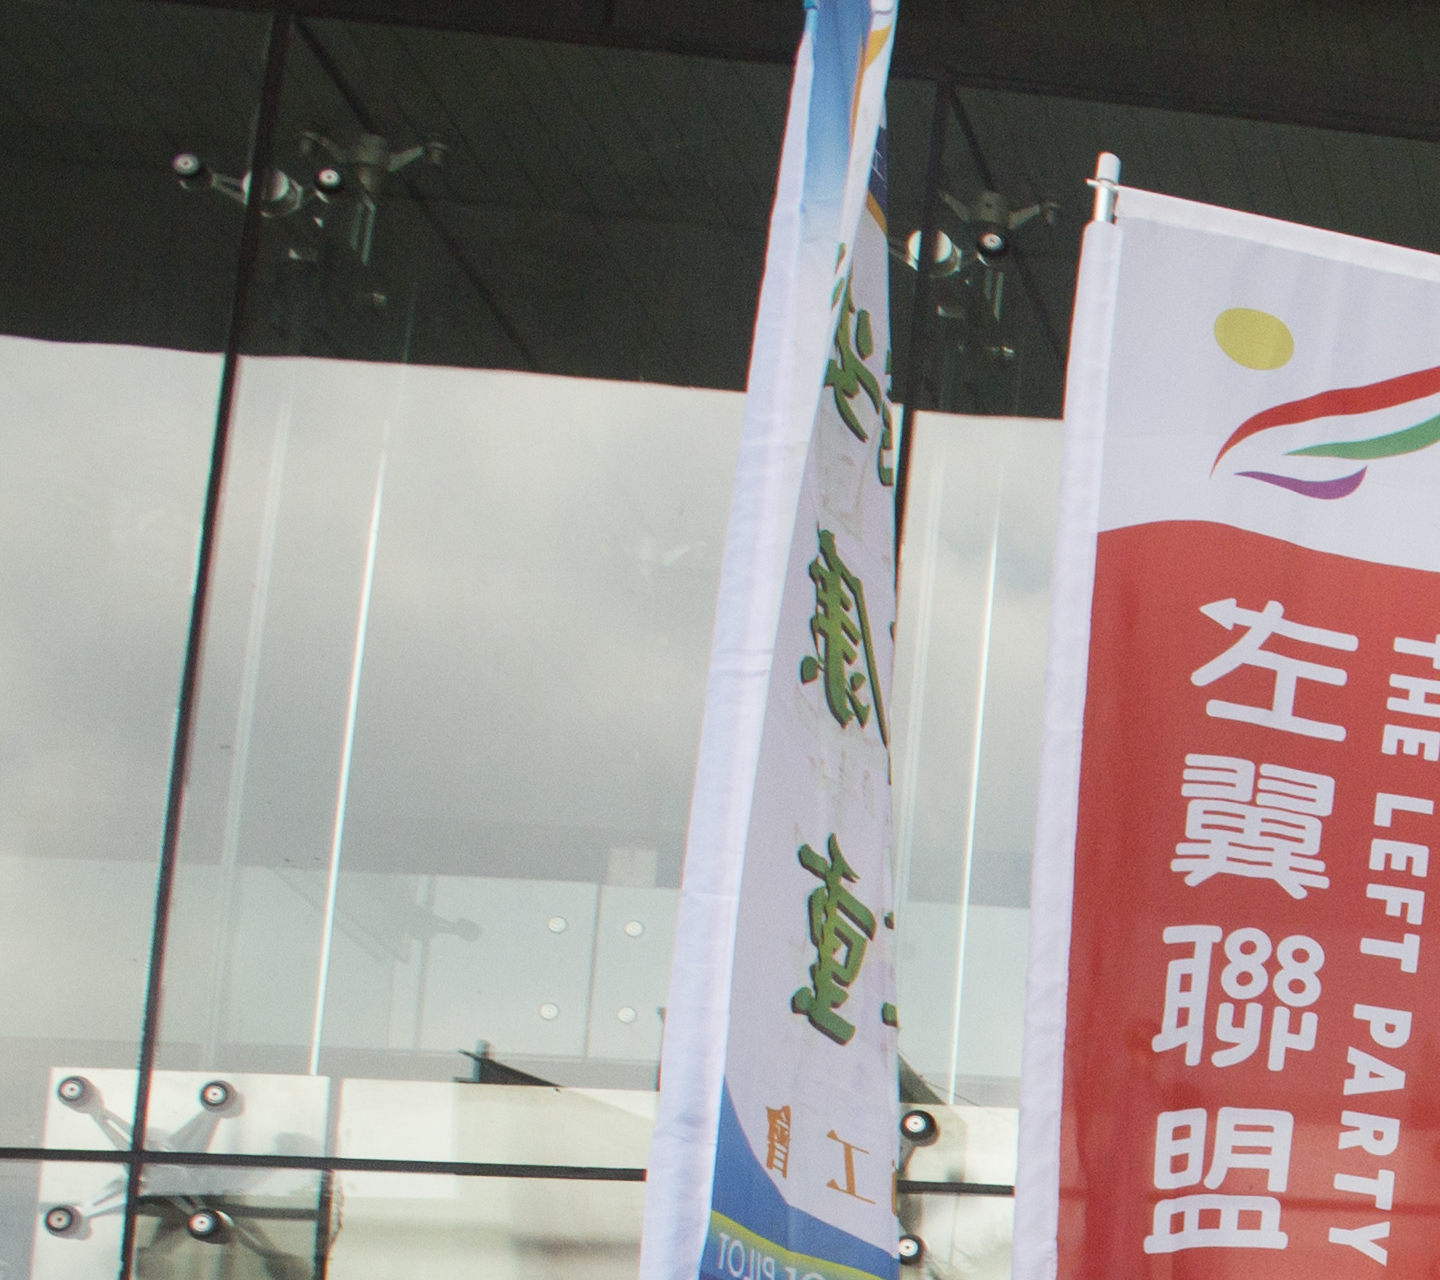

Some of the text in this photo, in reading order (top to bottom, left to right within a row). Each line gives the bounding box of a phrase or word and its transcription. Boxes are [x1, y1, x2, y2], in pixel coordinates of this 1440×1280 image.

[1143, 598, 1360, 1256] 左翼聯盟
[1359, 792, 1435, 974] LEFT
[1327, 1003, 1413, 1267] PARTY
